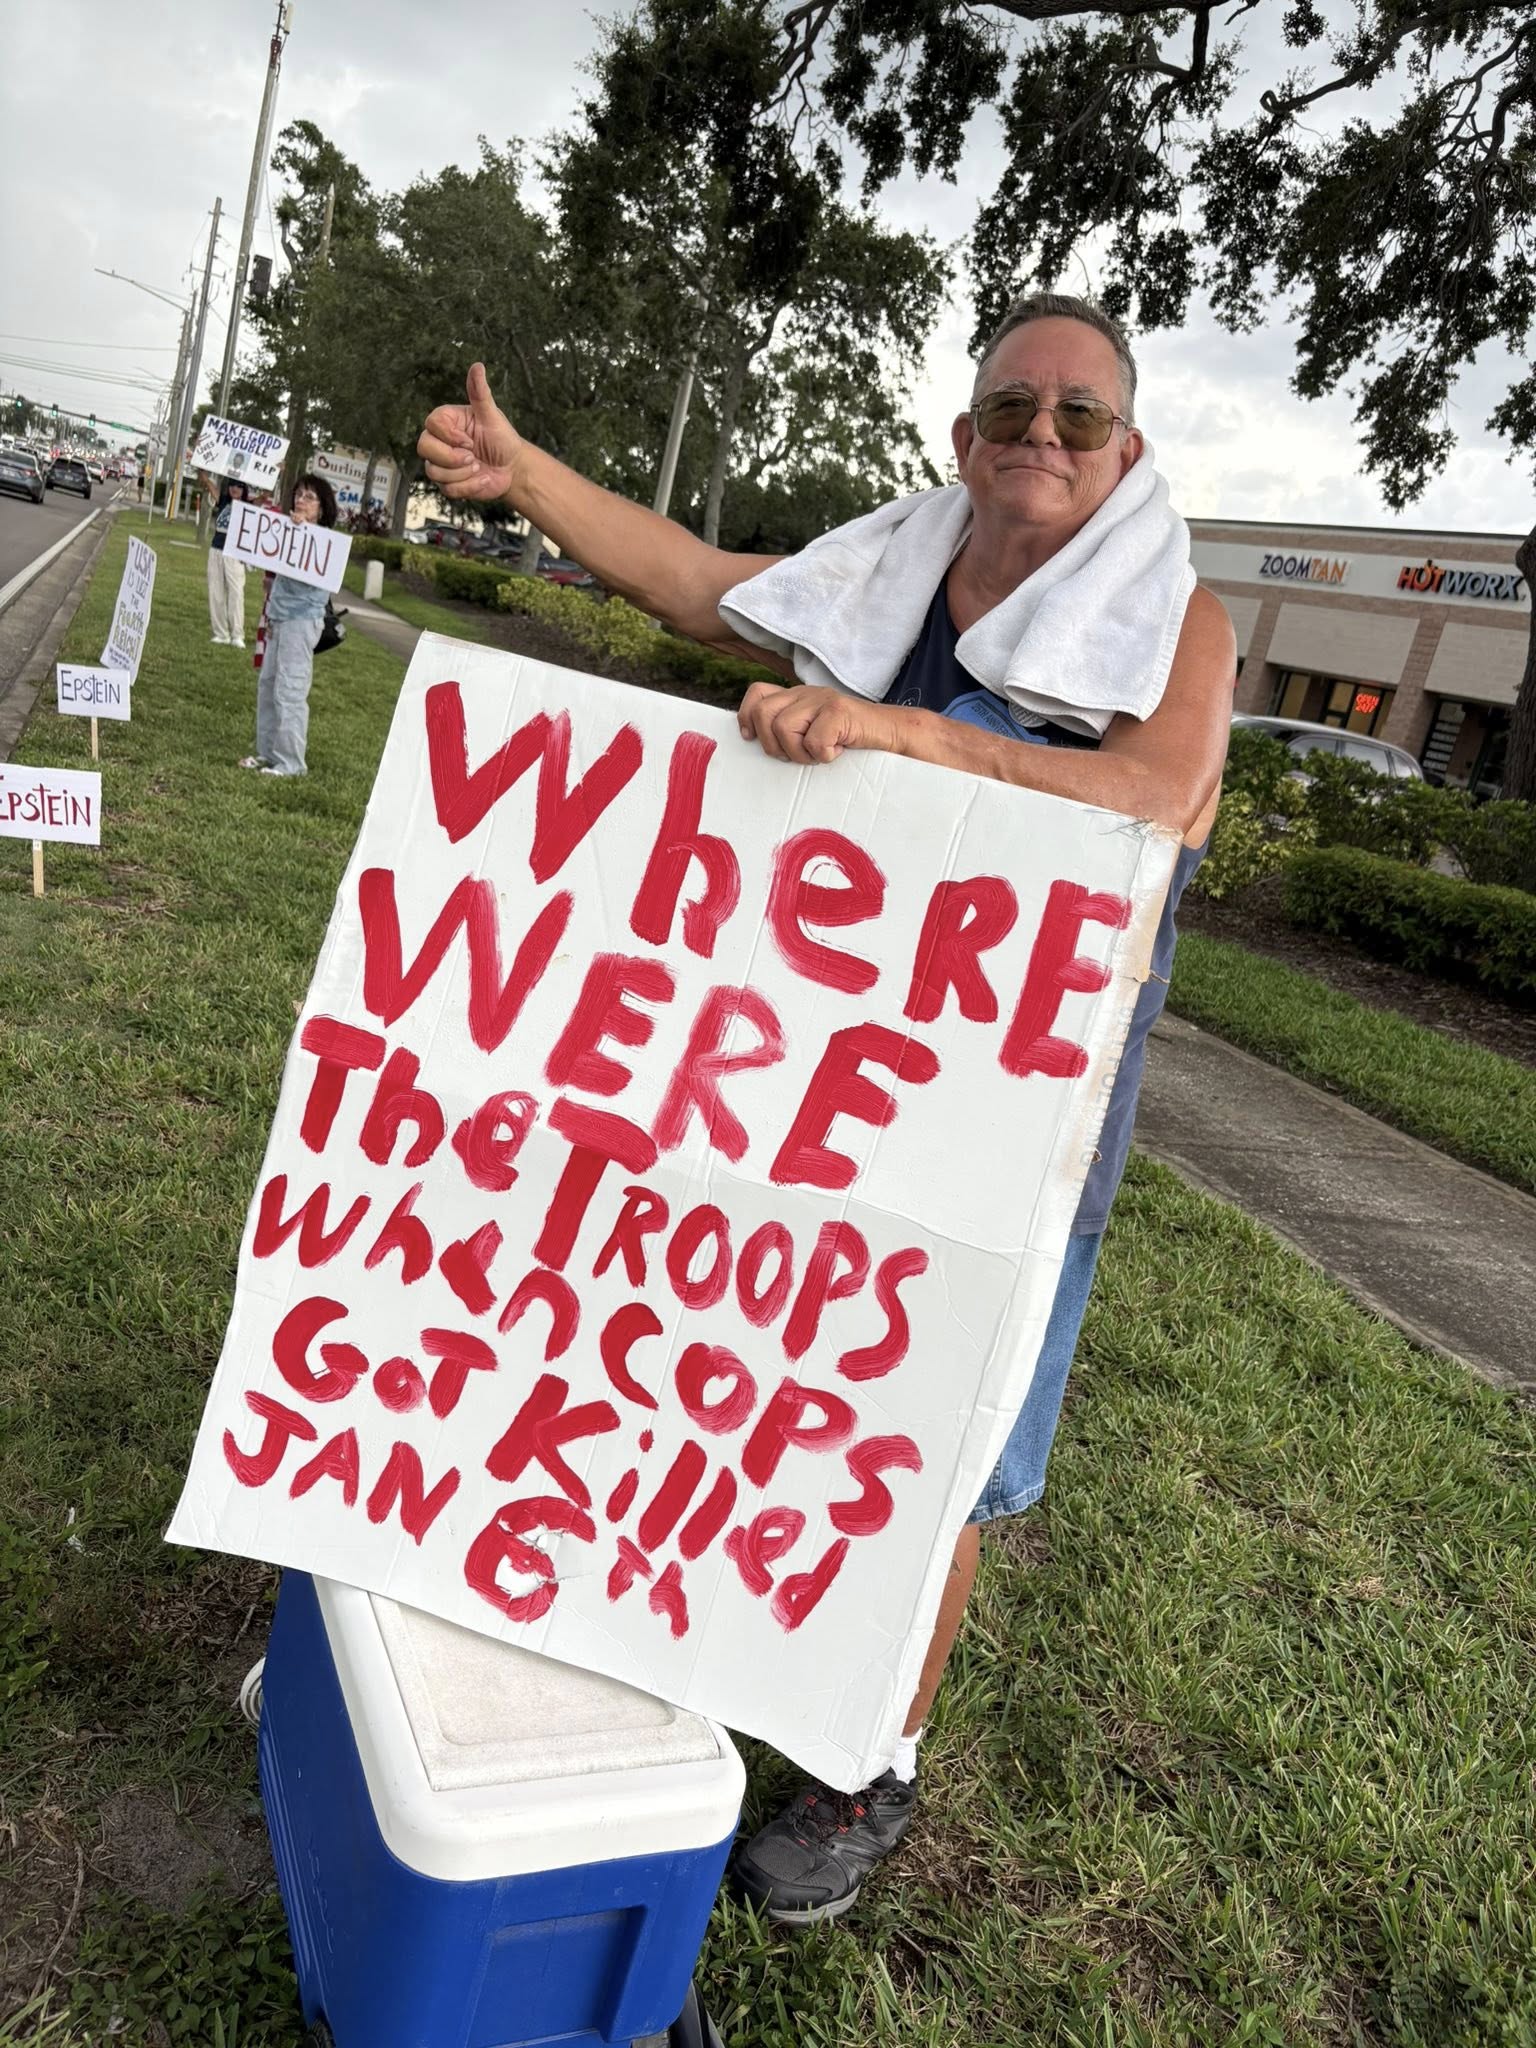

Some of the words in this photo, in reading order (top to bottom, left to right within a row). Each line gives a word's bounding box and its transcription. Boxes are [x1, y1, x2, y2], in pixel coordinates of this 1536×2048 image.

[208, 418, 248, 439] MAKE
[249, 430, 282, 449] GOOD
[216, 431, 268, 458] TROUBLE
[318, 456, 388, 484] Burlingon
[1397, 559, 1523, 601] HOTWORX
[358, 867, 940, 1190] WERE
[300, 1015, 538, 1193] The
[533, 1096, 929, 1382] TROOPS
[223, 1390, 461, 1545] JAN
[599, 1302, 923, 1537] COPS
